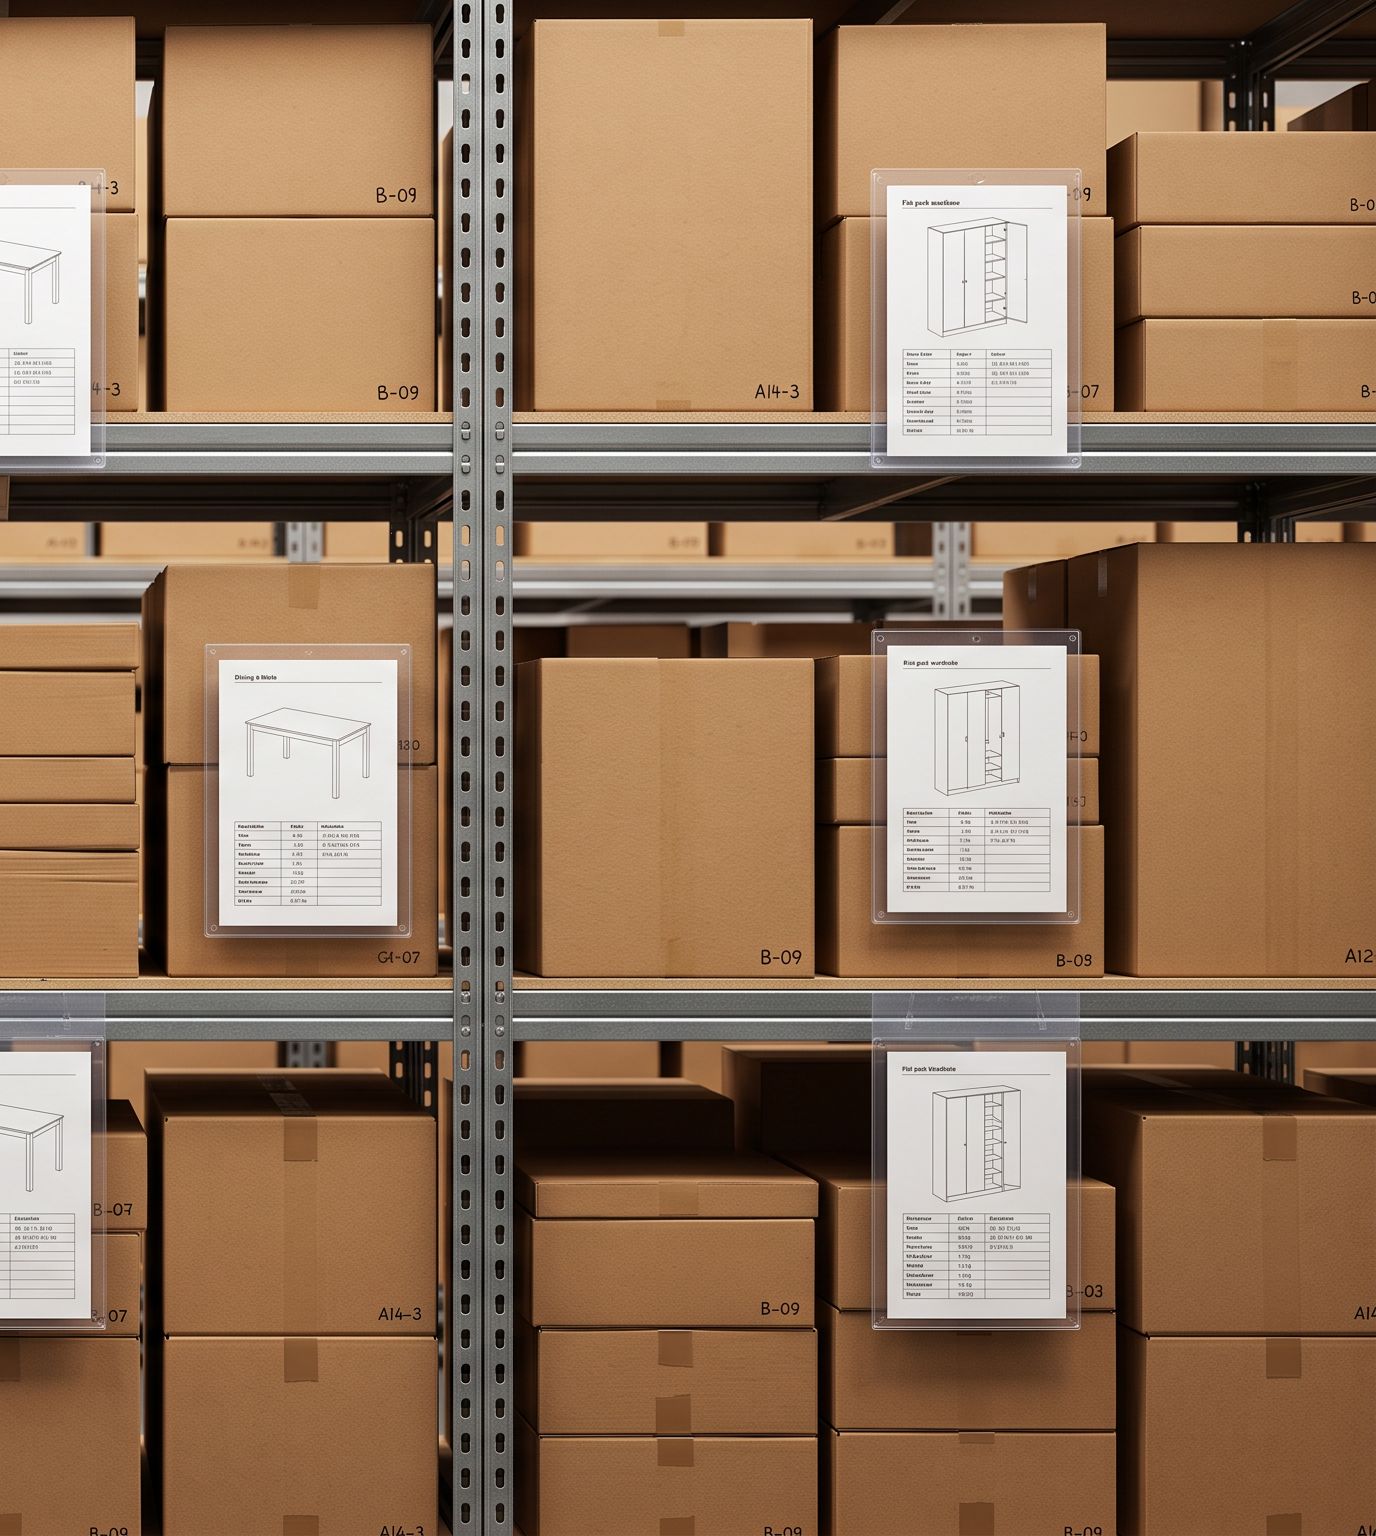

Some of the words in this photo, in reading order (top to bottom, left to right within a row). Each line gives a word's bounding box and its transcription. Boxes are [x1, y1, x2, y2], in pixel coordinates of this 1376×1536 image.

[376, 187, 417, 203] B-09
[377, 385, 419, 401] B-09
[755, 383, 800, 399] A14-3
[760, 948, 803, 966] B-09
[377, 1306, 422, 1321] A14-3
[760, 1301, 800, 1316] B-09
